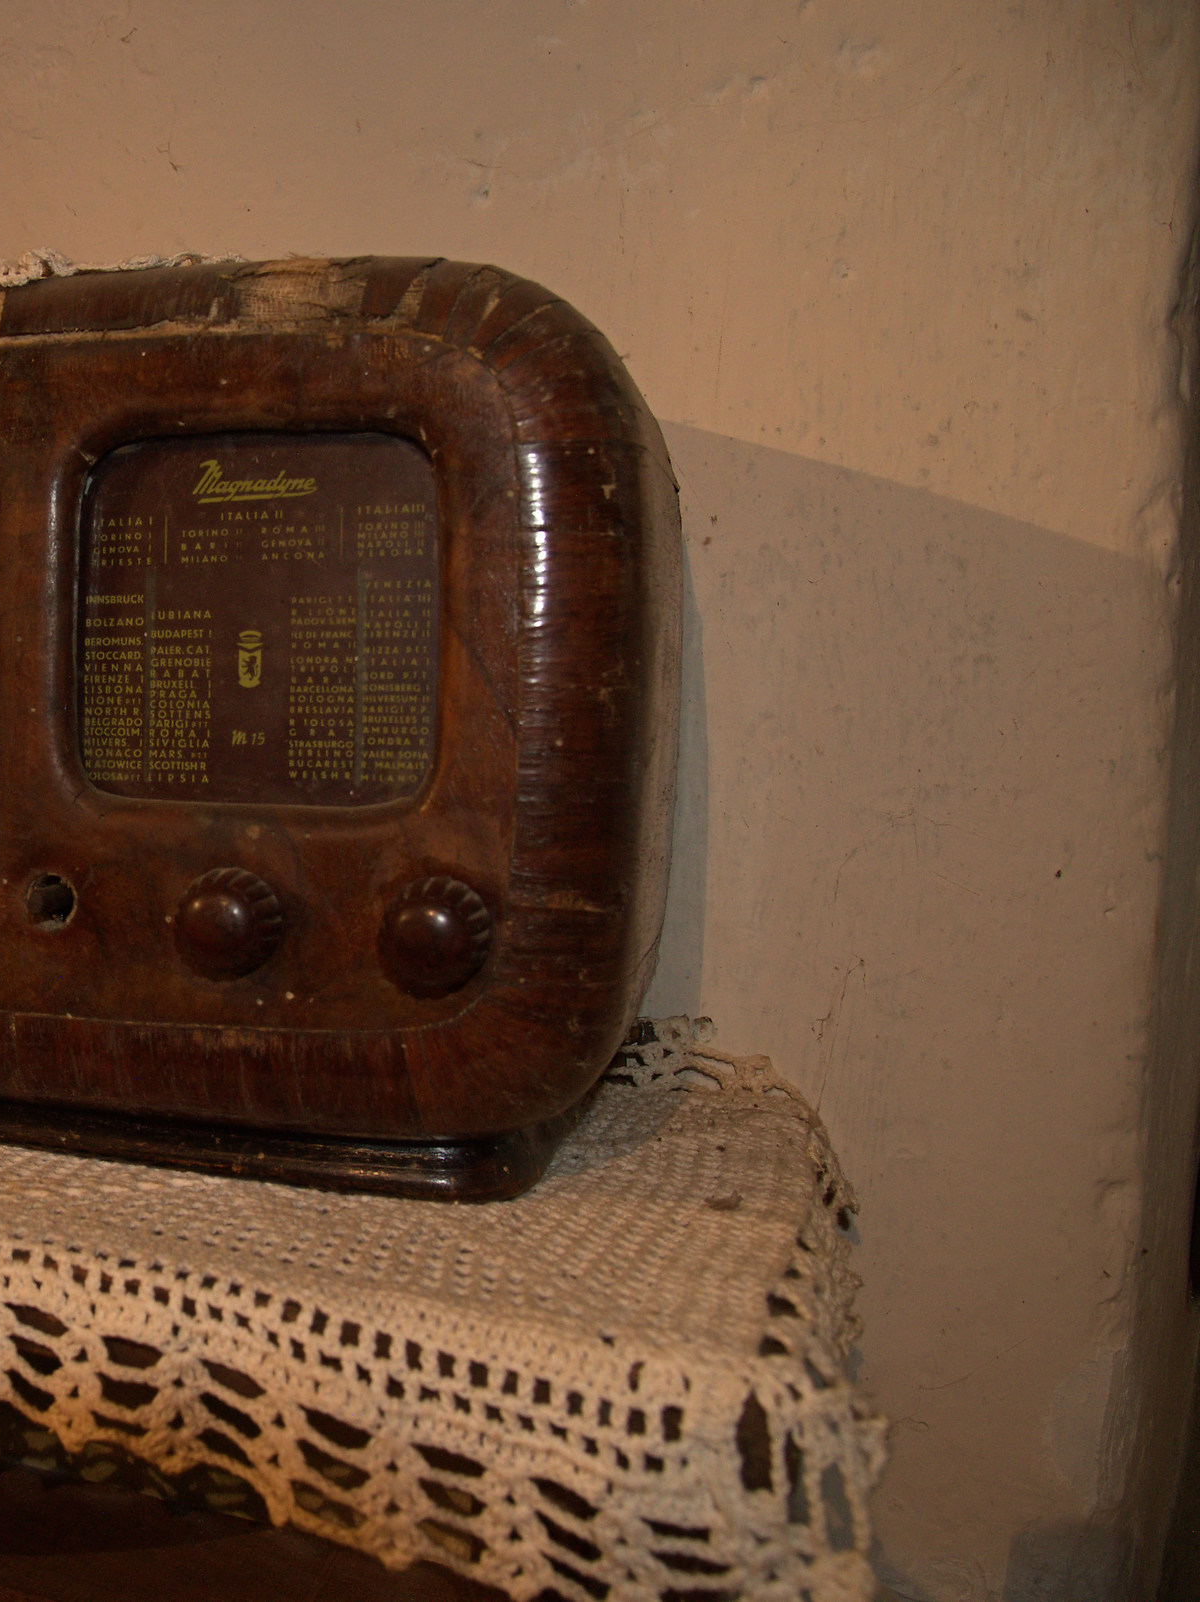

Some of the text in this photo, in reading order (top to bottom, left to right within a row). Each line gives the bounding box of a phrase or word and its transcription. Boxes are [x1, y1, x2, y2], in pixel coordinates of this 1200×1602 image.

[193, 459, 318, 504] Magnadyne
[358, 504, 409, 515] ITALIA
[220, 510, 269, 521] ITALIA
[93, 517, 142, 527] ITALIA
[358, 522, 409, 531] TORINO
[182, 528, 228, 538] TORINO
[262, 526, 308, 534] ROMA
[94, 533, 142, 542] TORINO
[181, 541, 227, 551] BARI
[262, 540, 312, 549] GENOVA
[357, 540, 409, 549] NAPOLI
[93, 546, 139, 555] GENOVA
[357, 548, 423, 557] VERONA
[181, 555, 228, 564] MILANO
[262, 551, 325, 560] ANCONA
[93, 557, 152, 566] TRIESTE
[365, 580, 431, 589] VENEZIA
[86, 594, 144, 605] INNSBRUCK
[291, 596, 332, 604] PARIGI
[151, 610, 211, 620] LUBIANA
[308, 608, 356, 616] LIONE
[86, 617, 144, 627] BOLZANO
[151, 630, 203, 638] BUDAPEST
[363, 630, 416, 638] FIRENZE
[363, 646, 398, 654] NIZZA
[85, 651, 143, 660] STOCCARD.
[290, 656, 338, 664] LONDRA
[151, 658, 211, 667] GRENOBLE
[84, 664, 143, 672] VIENNA
[291, 665, 356, 673] TRIPOLI
[150, 670, 210, 678] RABAT
[84, 675, 129, 684] FIRENZE
[84, 686, 143, 694] LISBONA
[290, 684, 354, 693] BARCELLONA
[150, 690, 197, 699] PRAGA
[362, 695, 417, 703] HILVERSUM
[85, 696, 122, 705] LIONE
[150, 700, 210, 709] COLONIA
[85, 707, 127, 716] NORTH
[150, 710, 210, 719] SOTTENS
[290, 706, 354, 714] BRESLAVIA
[85, 718, 143, 726] BELGRADO
[150, 720, 188, 728] PARIGI
[304, 719, 354, 727] TOLOSA
[362, 716, 416, 724] BRUXELLES
[150, 729, 196, 738] ROMA
[290, 728, 353, 736] GRAZ
[363, 726, 429, 735] AMBURGO
[252, 732, 265, 745] 15
[361, 737, 410, 745] LONDRA
[150, 739, 209, 748] SIVIGLIA
[289, 740, 354, 748] STRASBURGO
[84, 749, 142, 758] MONACO
[288, 749, 353, 758] BERLINO
[86, 760, 142, 770] KATOWICE
[149, 761, 197, 770] SCOTTISH
[288, 760, 353, 768] BUCAREST
[88, 772, 124, 781] OLOSA
[148, 773, 209, 783] LIPSIA
[289, 771, 338, 780] WELSH
[360, 773, 418, 782] MILANO
